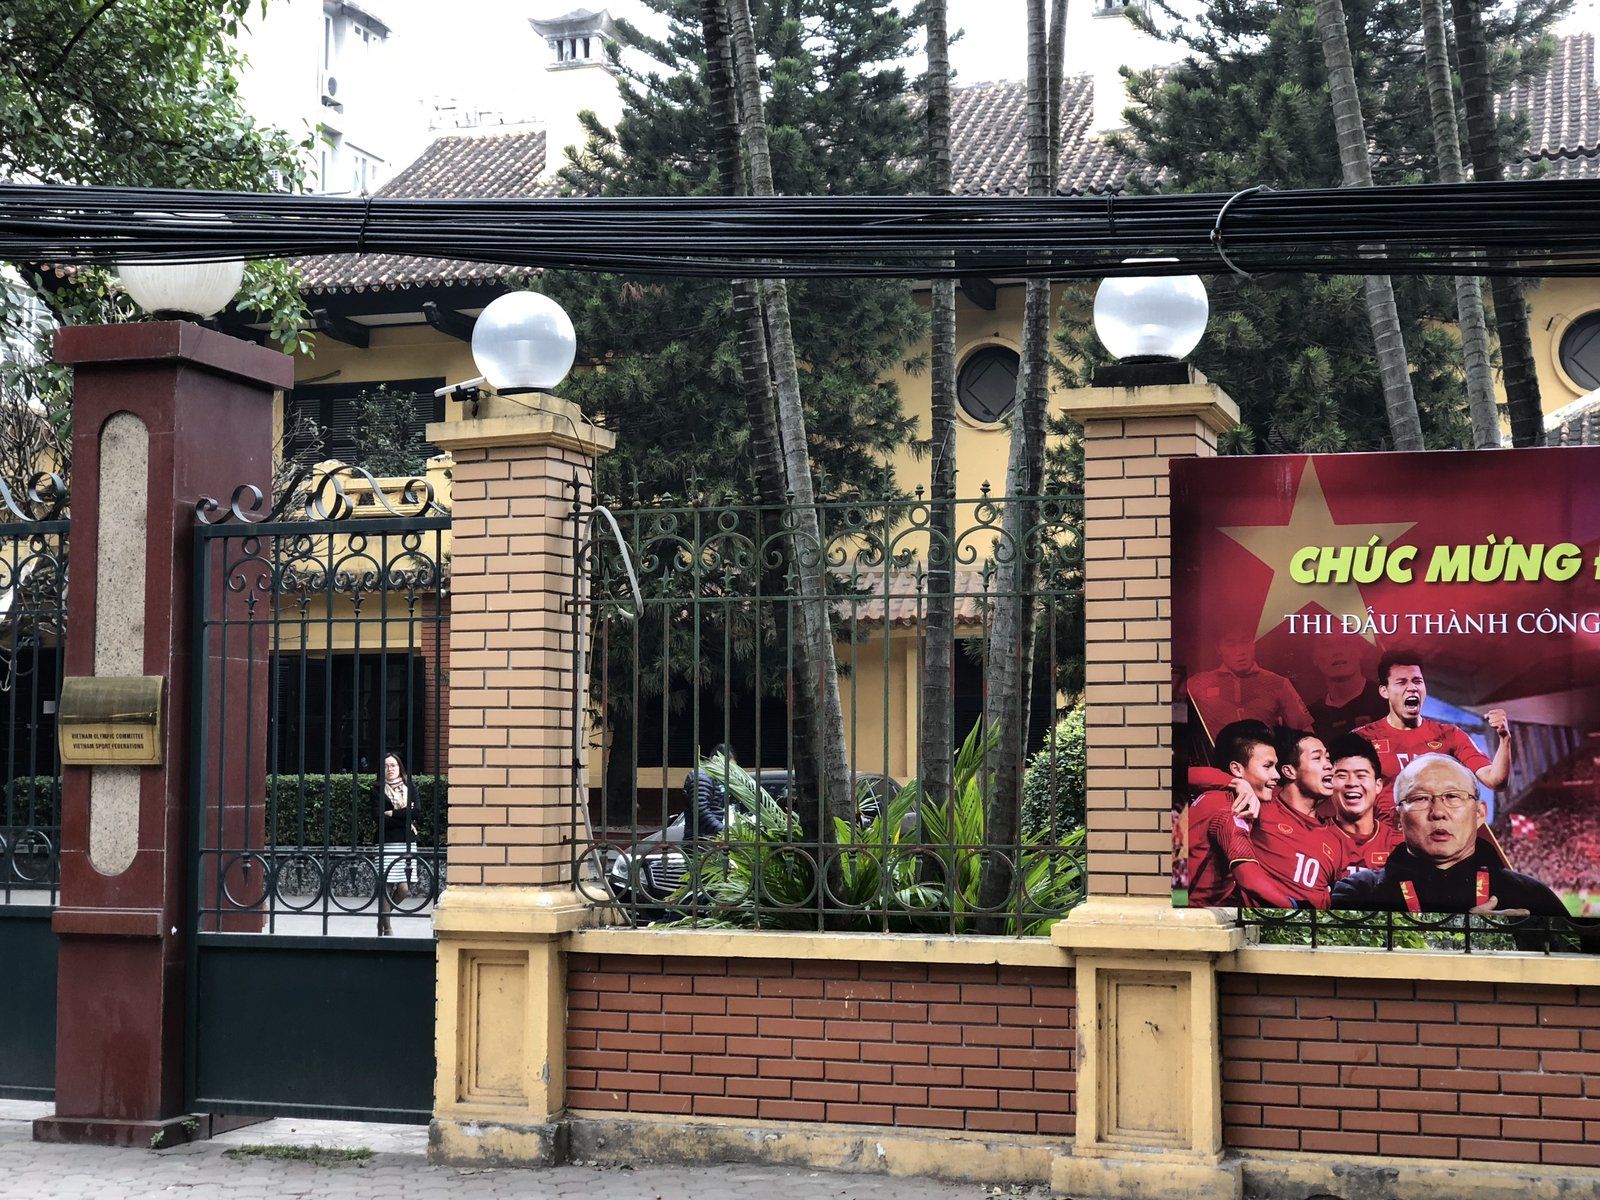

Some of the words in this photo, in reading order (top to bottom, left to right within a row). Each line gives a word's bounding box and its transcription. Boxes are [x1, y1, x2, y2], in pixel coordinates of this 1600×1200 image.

[1289, 535, 1418, 584] CHÚC
[1424, 533, 1583, 583] MỪNG
[1284, 613, 1334, 635] THI
[1341, 605, 1399, 635] ĐẤU
[1405, 608, 1509, 635] THÀNH
[1516, 607, 1600, 634] CÔNG
[1293, 852, 1320, 888] 10
